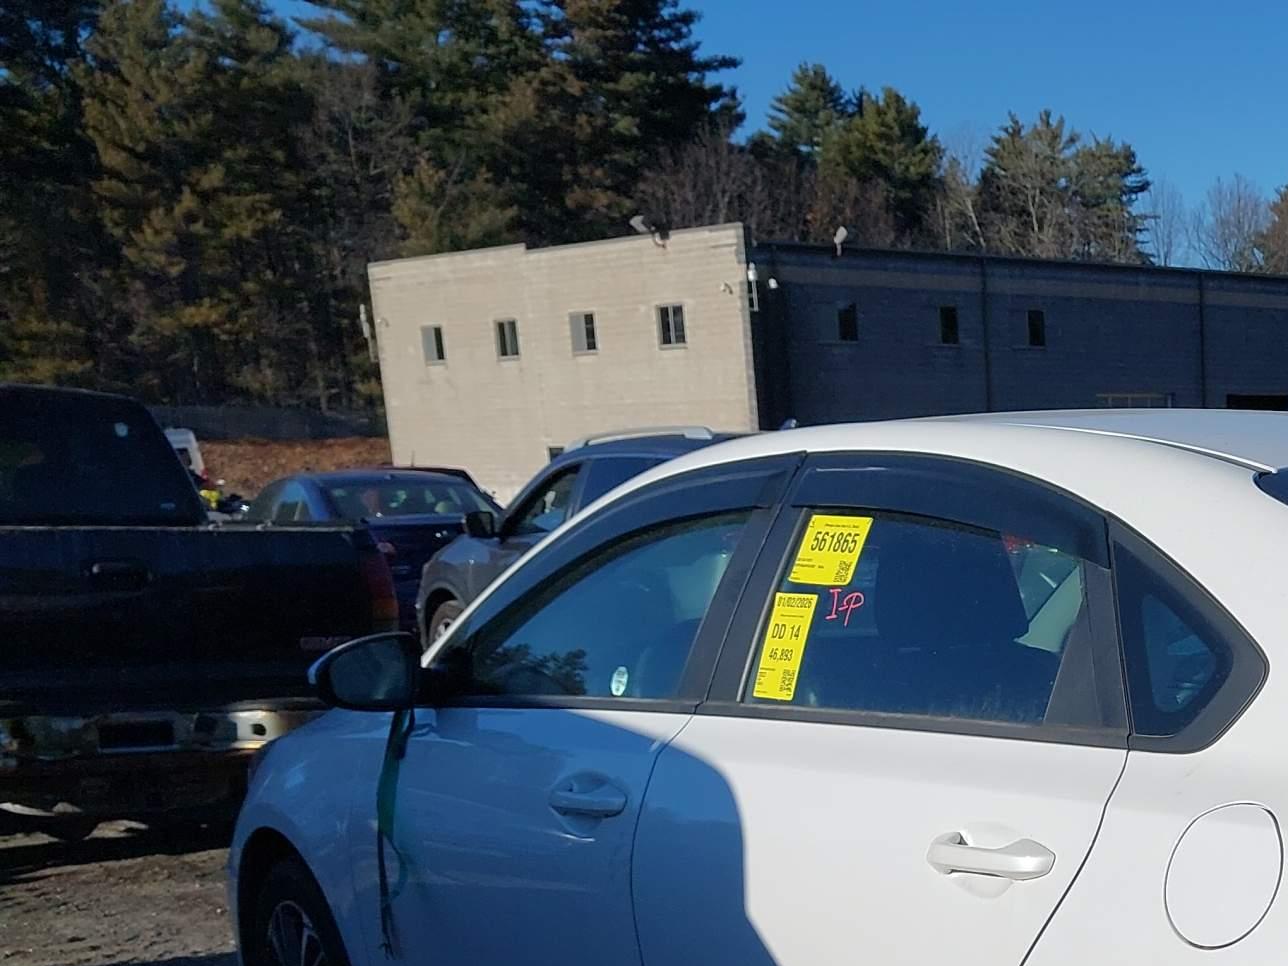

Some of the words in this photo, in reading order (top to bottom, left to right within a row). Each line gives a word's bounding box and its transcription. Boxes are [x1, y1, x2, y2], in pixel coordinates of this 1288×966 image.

[810, 531, 860, 554] 561865
[771, 623, 787, 640] DD
[789, 624, 802, 641] 14
